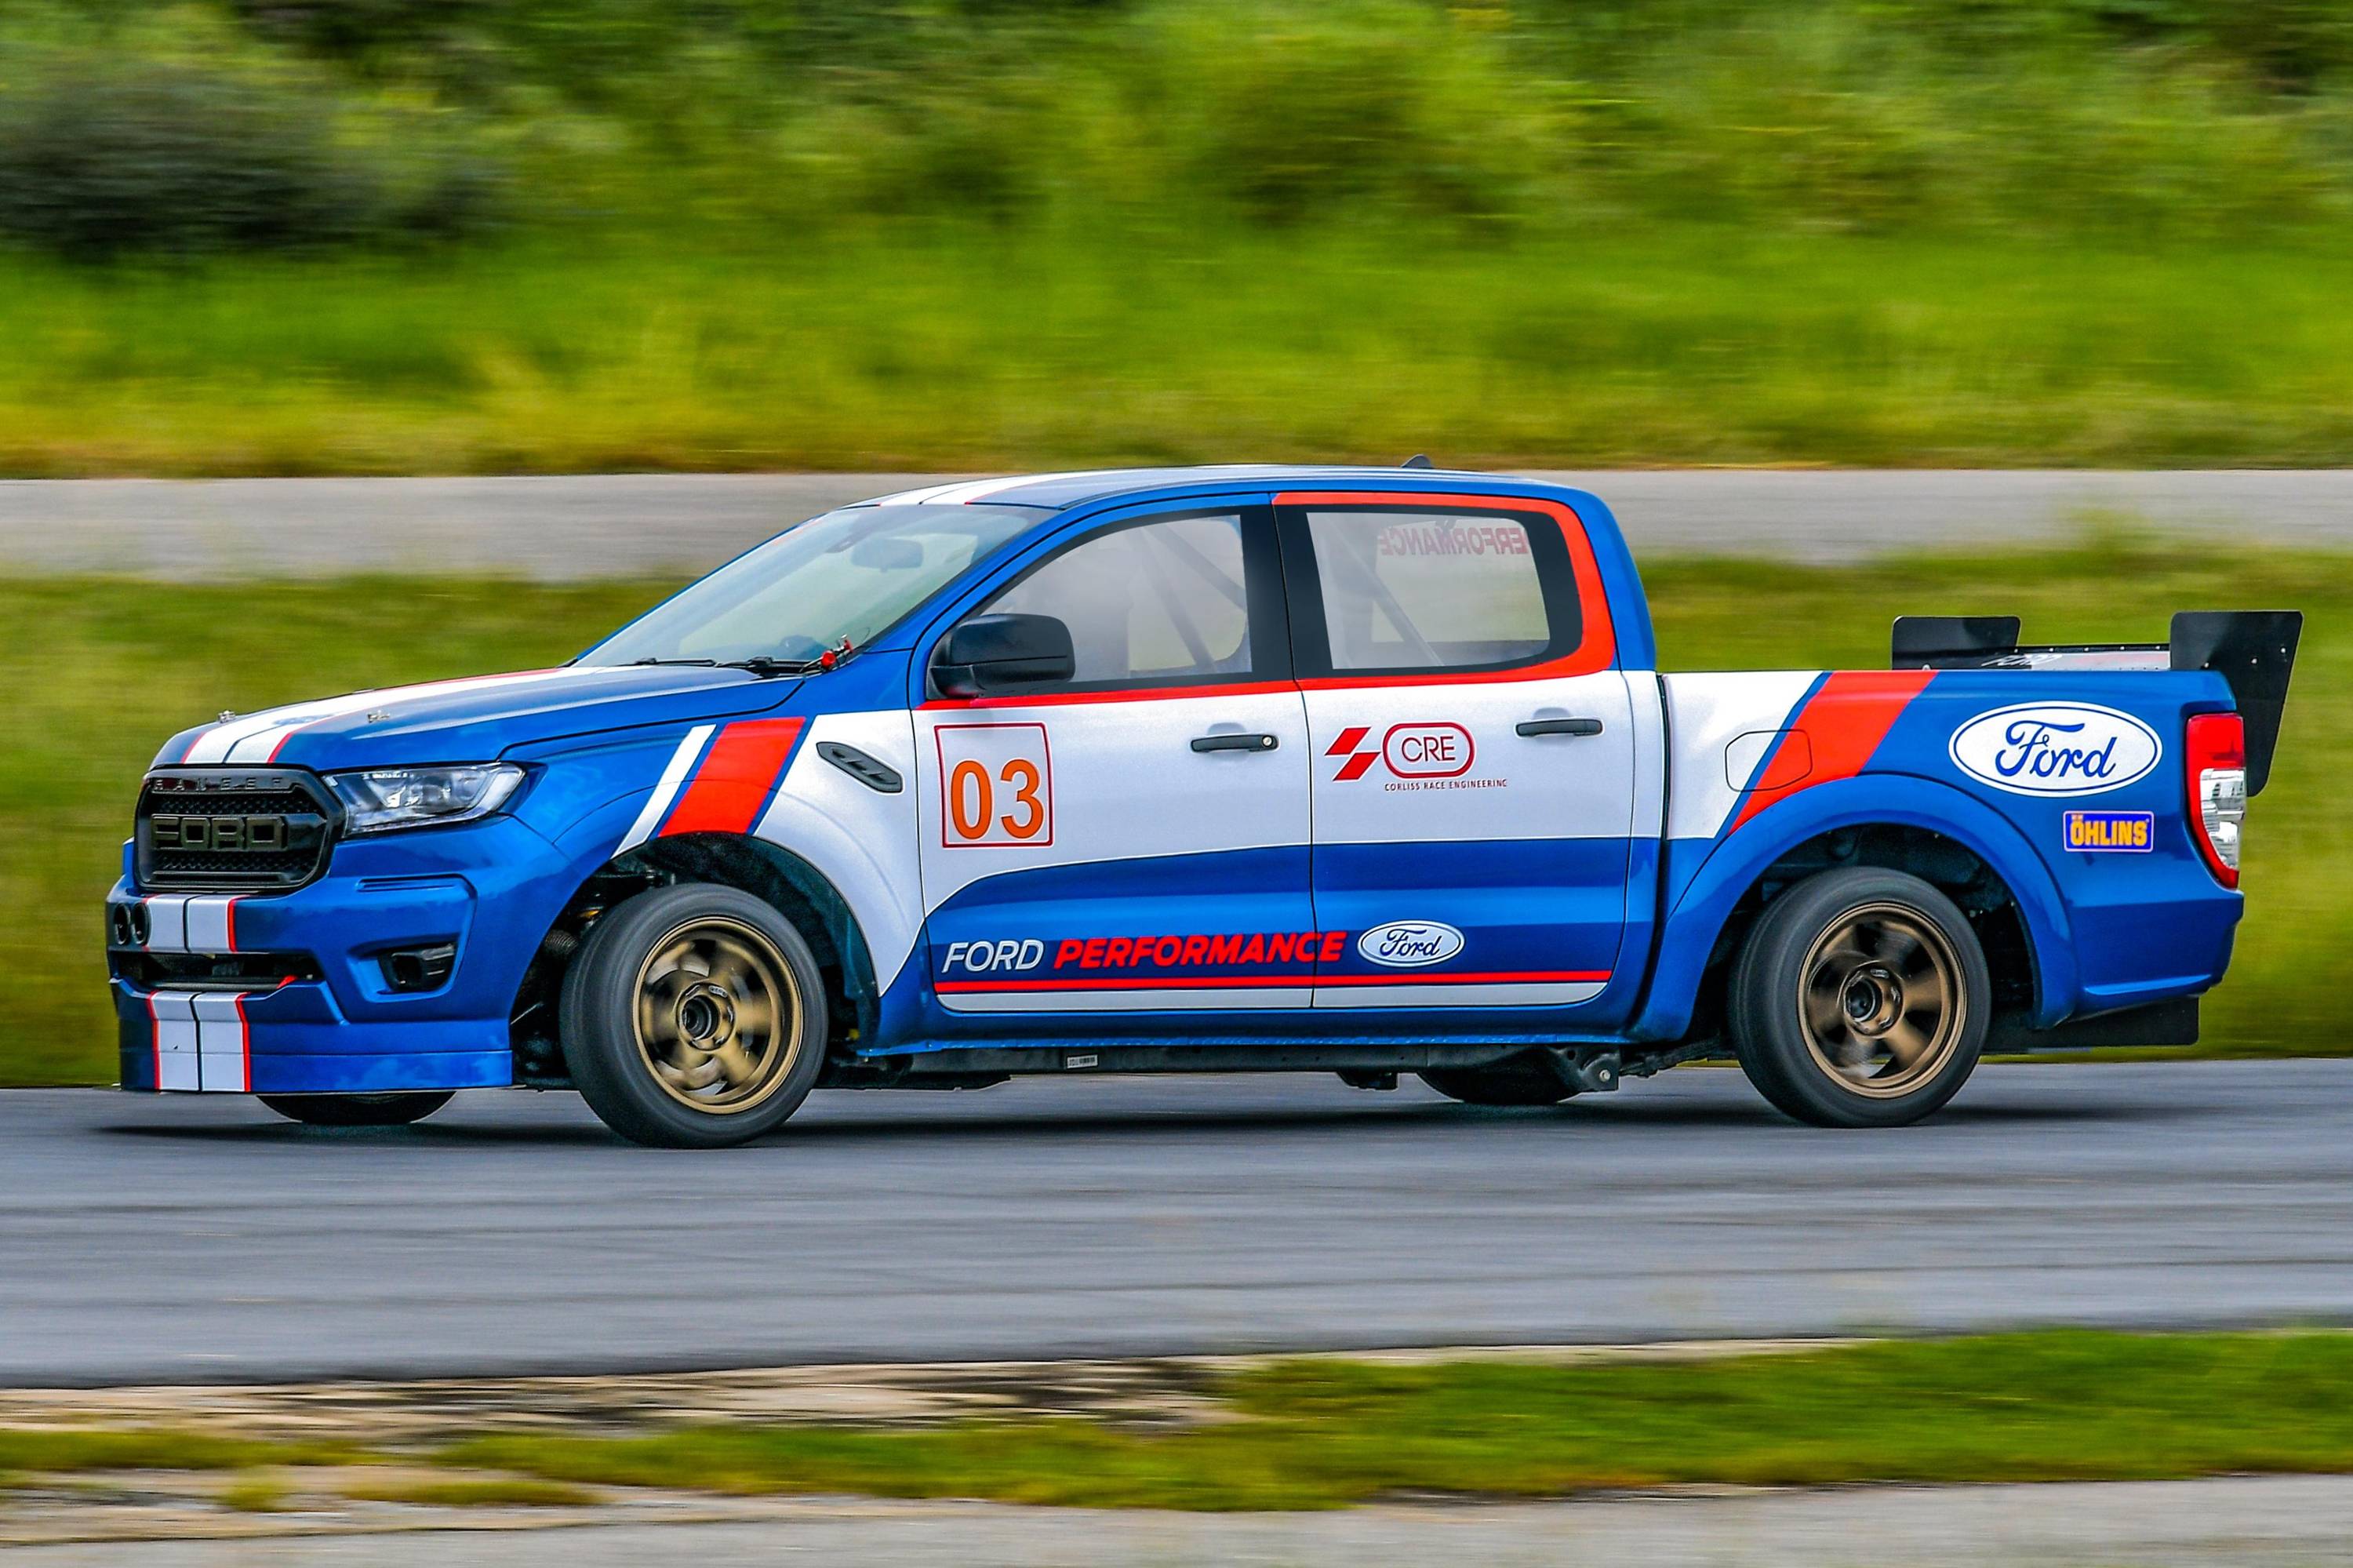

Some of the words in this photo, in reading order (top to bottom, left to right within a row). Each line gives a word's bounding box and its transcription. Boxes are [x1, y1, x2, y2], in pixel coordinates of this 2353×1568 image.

[1401, 736, 1457, 762] CRE
[1995, 720, 2118, 778] Ford
[951, 759, 1045, 839] 03
[1384, 782, 1420, 791] CORLISS
[1424, 781, 1446, 790] RACE
[1449, 779, 1507, 789] ENGINEERING
[151, 816, 289, 851] FORD
[2070, 813, 2148, 846] ÖHLINS
[942, 939, 1044, 973] FORD
[1053, 931, 1347, 969] PERFORMANCE
[1380, 929, 1442, 956] Ford
